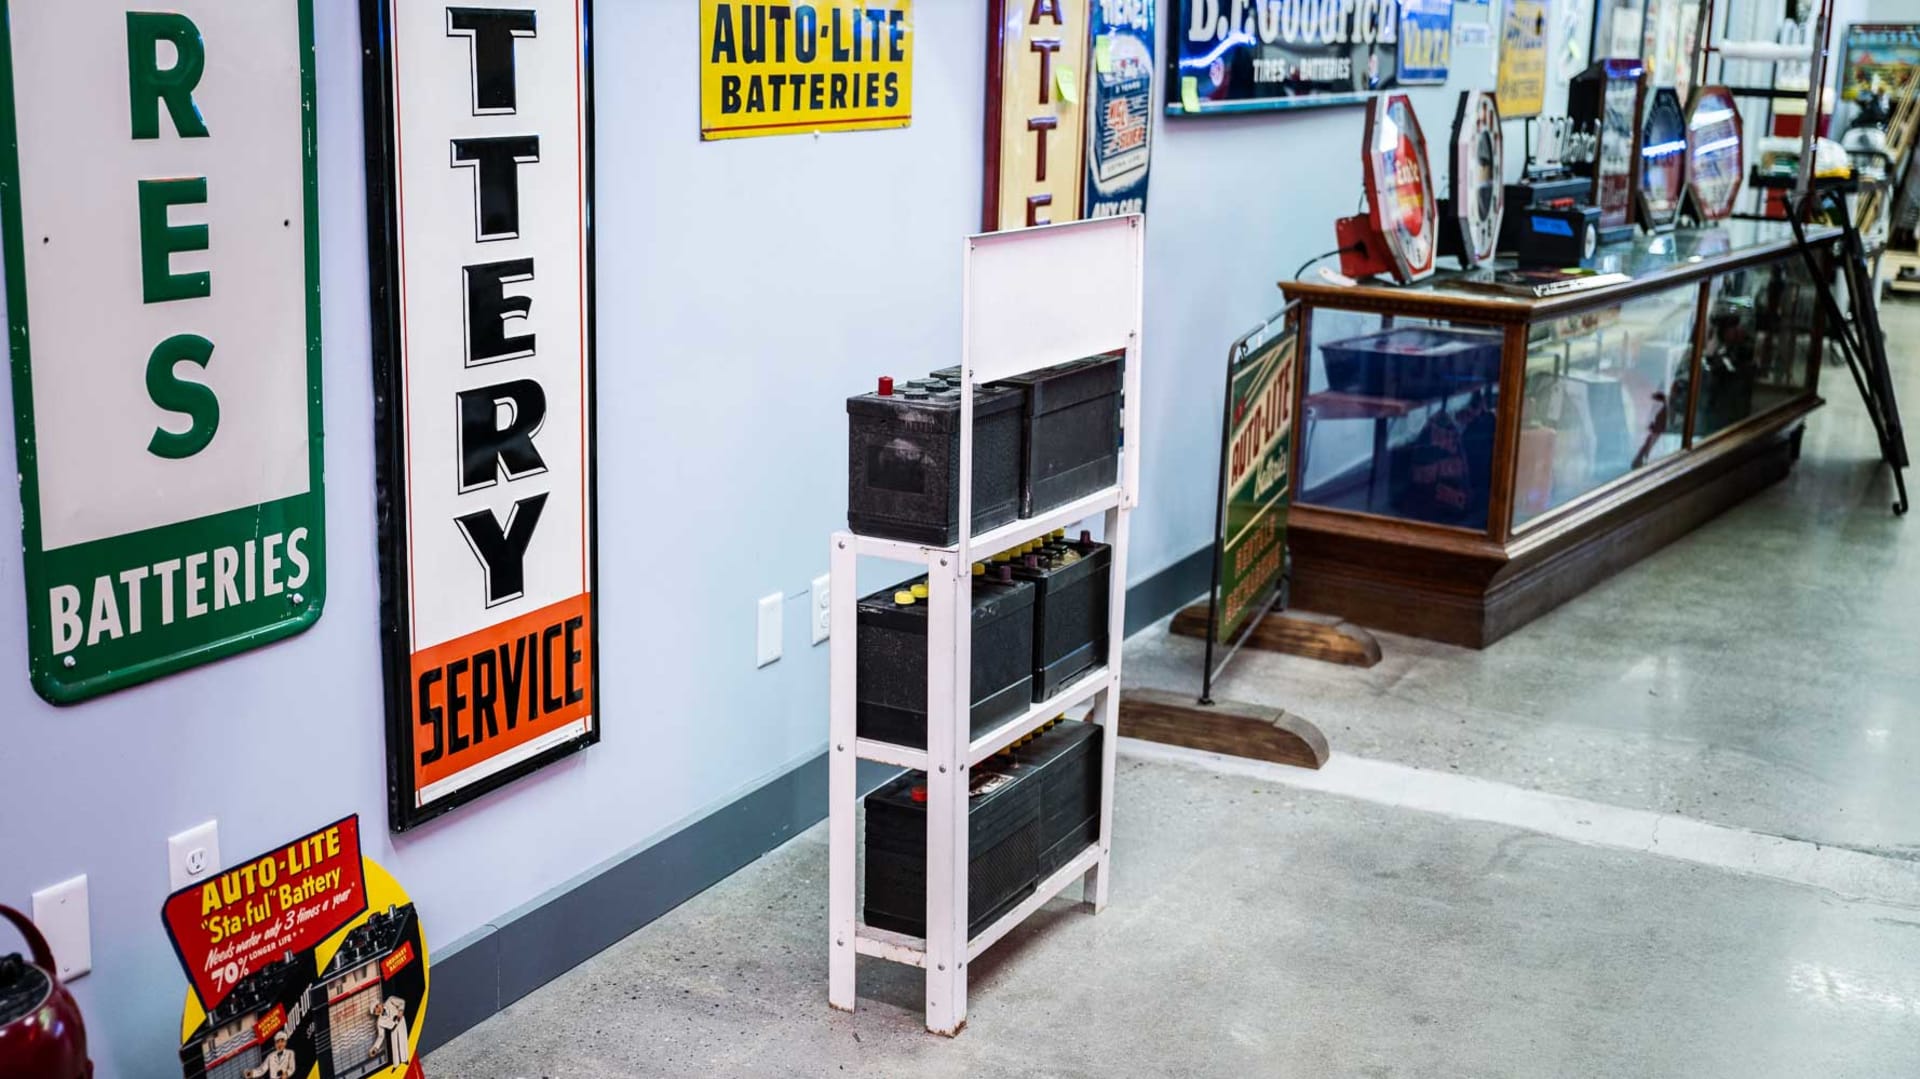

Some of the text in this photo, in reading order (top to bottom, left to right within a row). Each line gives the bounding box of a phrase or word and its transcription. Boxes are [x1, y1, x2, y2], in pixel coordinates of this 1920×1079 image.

[711, 4, 904, 64] AUTO-LITE
[1253, 59, 1285, 83] TIRES
[721, 72, 899, 114] BATTERIES
[125, 10, 221, 460] RES
[445, 6, 550, 610] TTERY
[1231, 357, 1292, 487] AUTO-LITE
[49, 527, 310, 656] BATTERIES
[419, 616, 584, 767] SERVICE
[201, 826, 341, 917] AUTO-LITE
[278, 866, 341, 911] Battery
[204, 941, 234, 973] Needs
[236, 931, 262, 955] water
[264, 918, 283, 939] only
[283, 910, 296, 931] 3
[296, 902, 321, 926] times
[322, 900, 330, 912] a
[211, 956, 250, 993] 70%
[249, 942, 277, 961] LONGER
